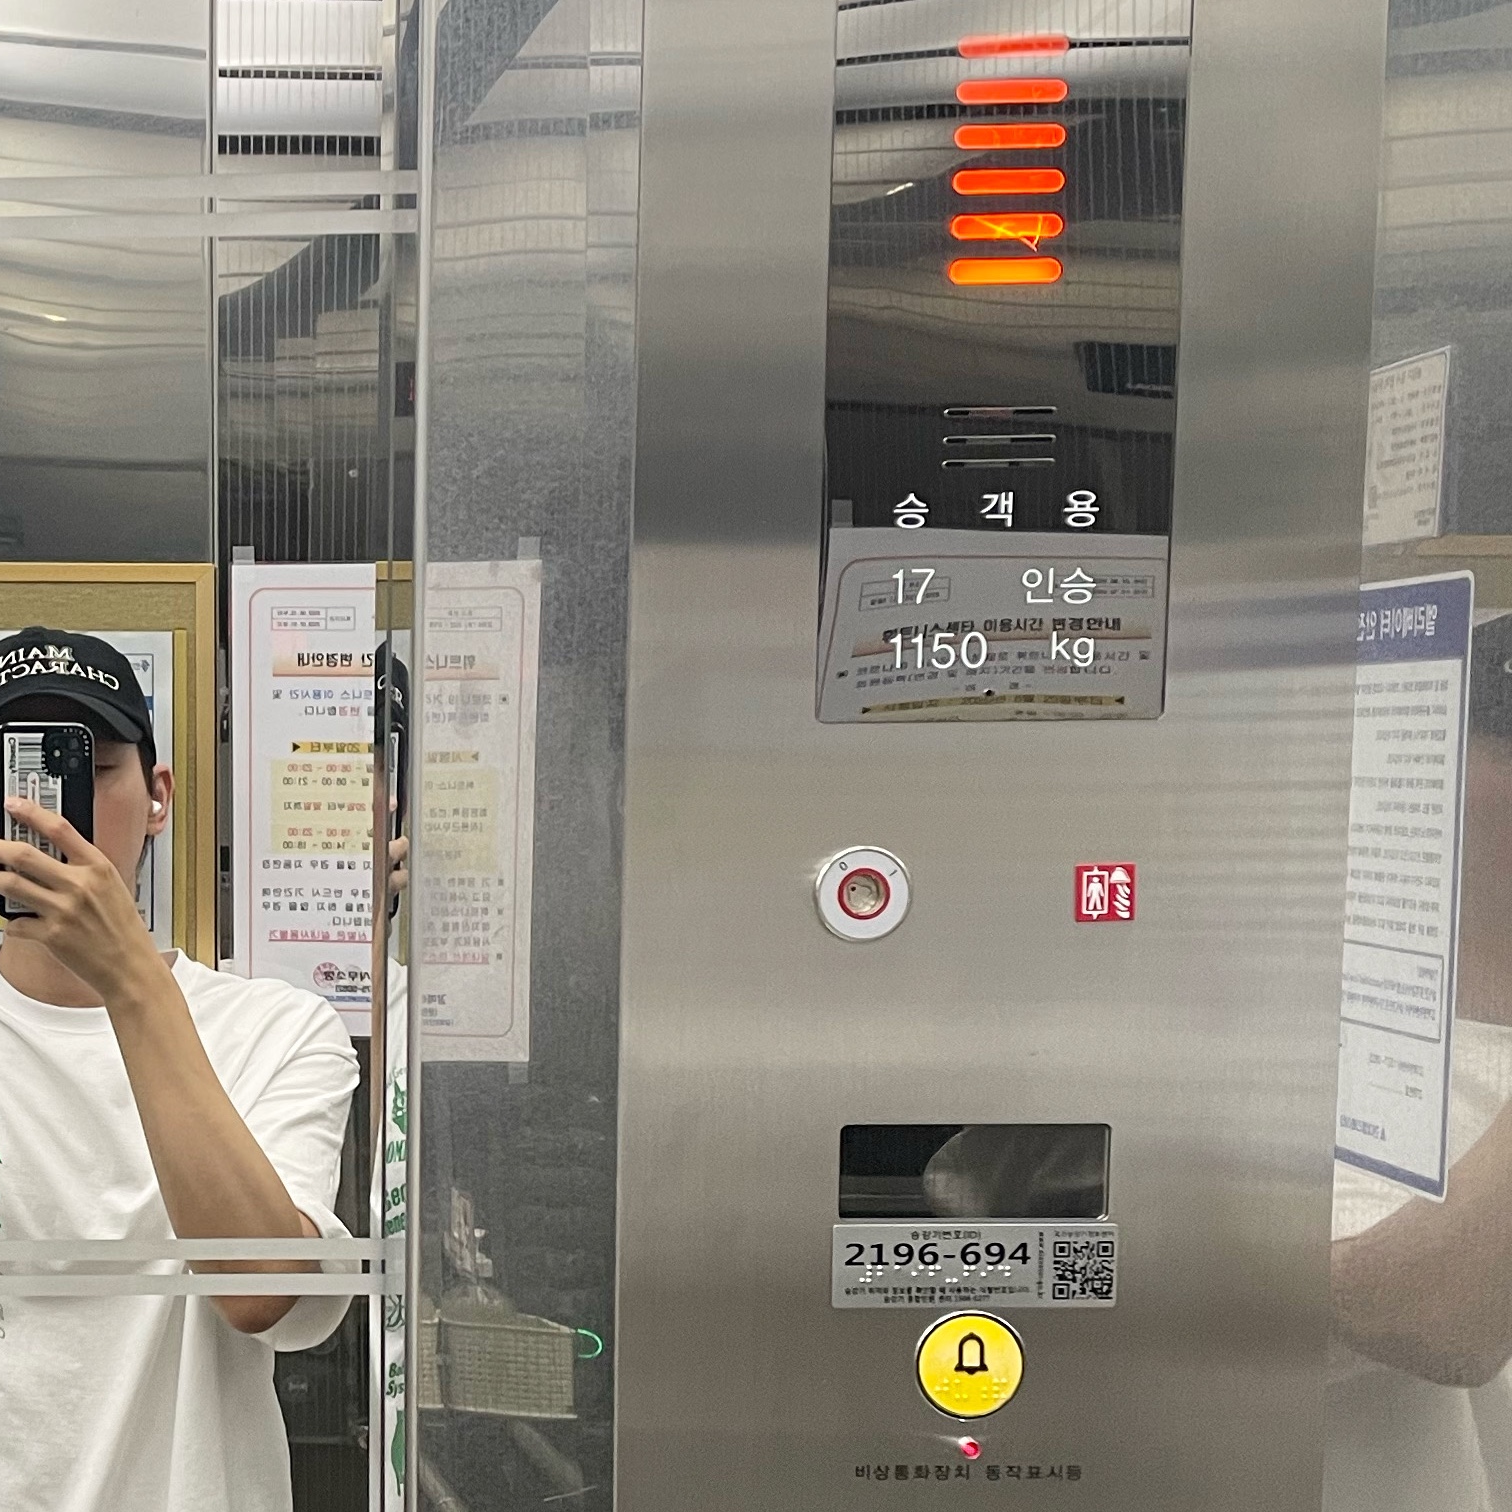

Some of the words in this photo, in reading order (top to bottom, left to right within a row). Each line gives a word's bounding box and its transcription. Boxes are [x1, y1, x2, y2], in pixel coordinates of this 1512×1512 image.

[894, 493, 929, 528] 승
[980, 491, 1013, 527] 객
[1064, 490, 1099, 527] 용
[892, 569, 936, 604] 17
[1022, 567, 1097, 605] 인승
[984, 618, 1043, 632] 이용시간
[889, 631, 988, 669] 1150
[1051, 632, 1095, 667] kg
[911, 1231, 982, 1240] 승강기번호(ID)
[845, 1242, 1031, 1266] 2196-694
[855, 1464, 970, 1481] 비상통화장치
[986, 1464, 1082, 1481] 동작표시등
